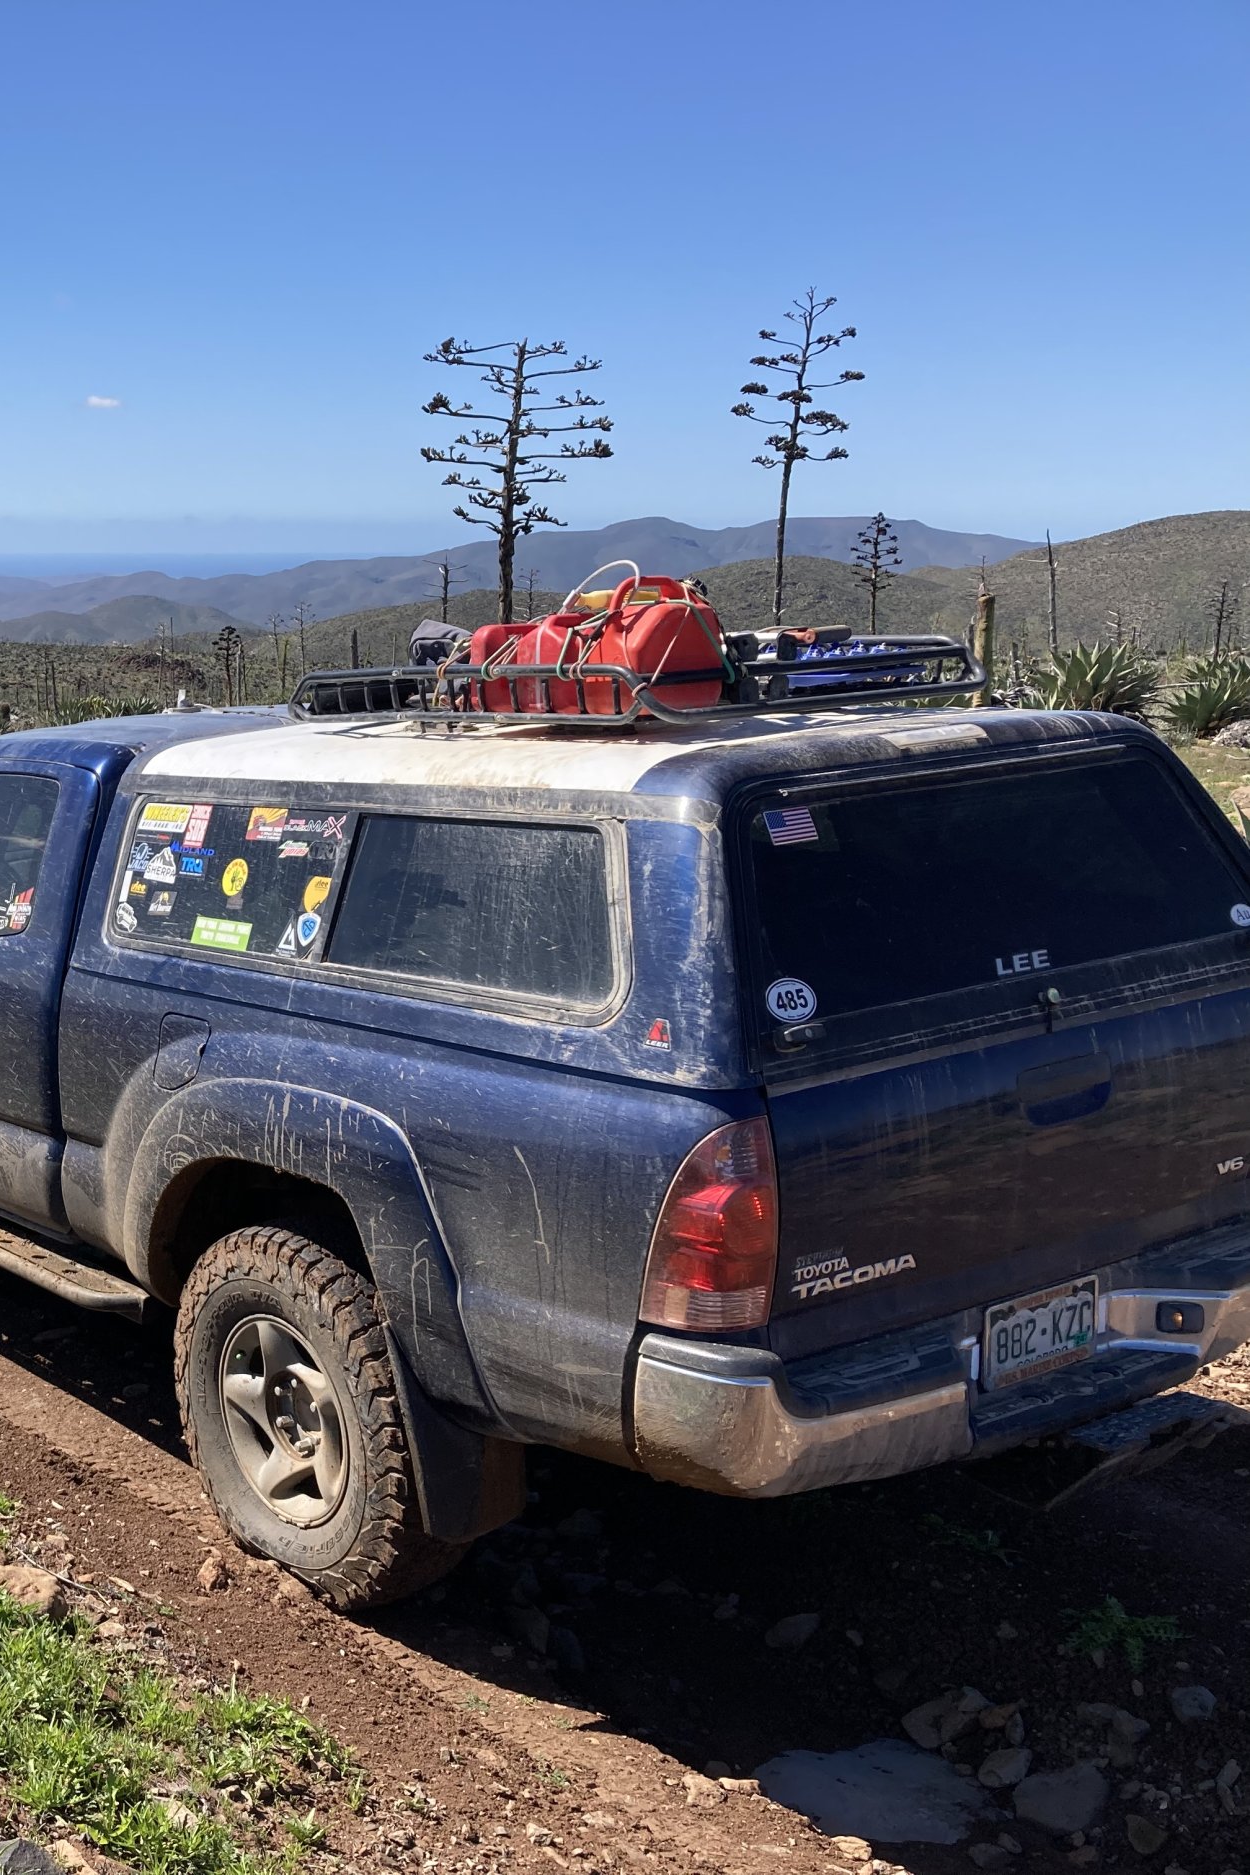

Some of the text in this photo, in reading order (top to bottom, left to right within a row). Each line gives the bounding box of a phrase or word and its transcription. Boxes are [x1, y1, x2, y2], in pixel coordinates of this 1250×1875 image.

[170, 840, 215, 856] MIDLAND
[147, 864, 176, 876] SHERPA
[182, 857, 203, 873] TRQ
[995, 949, 1051, 976] LEE
[776, 988, 809, 1012] 485
[645, 1039, 669, 1049] LEER
[1216, 1156, 1244, 1175] V6
[790, 1253, 917, 1299] TACOMA
[793, 1256, 850, 1281] TOYOTA
